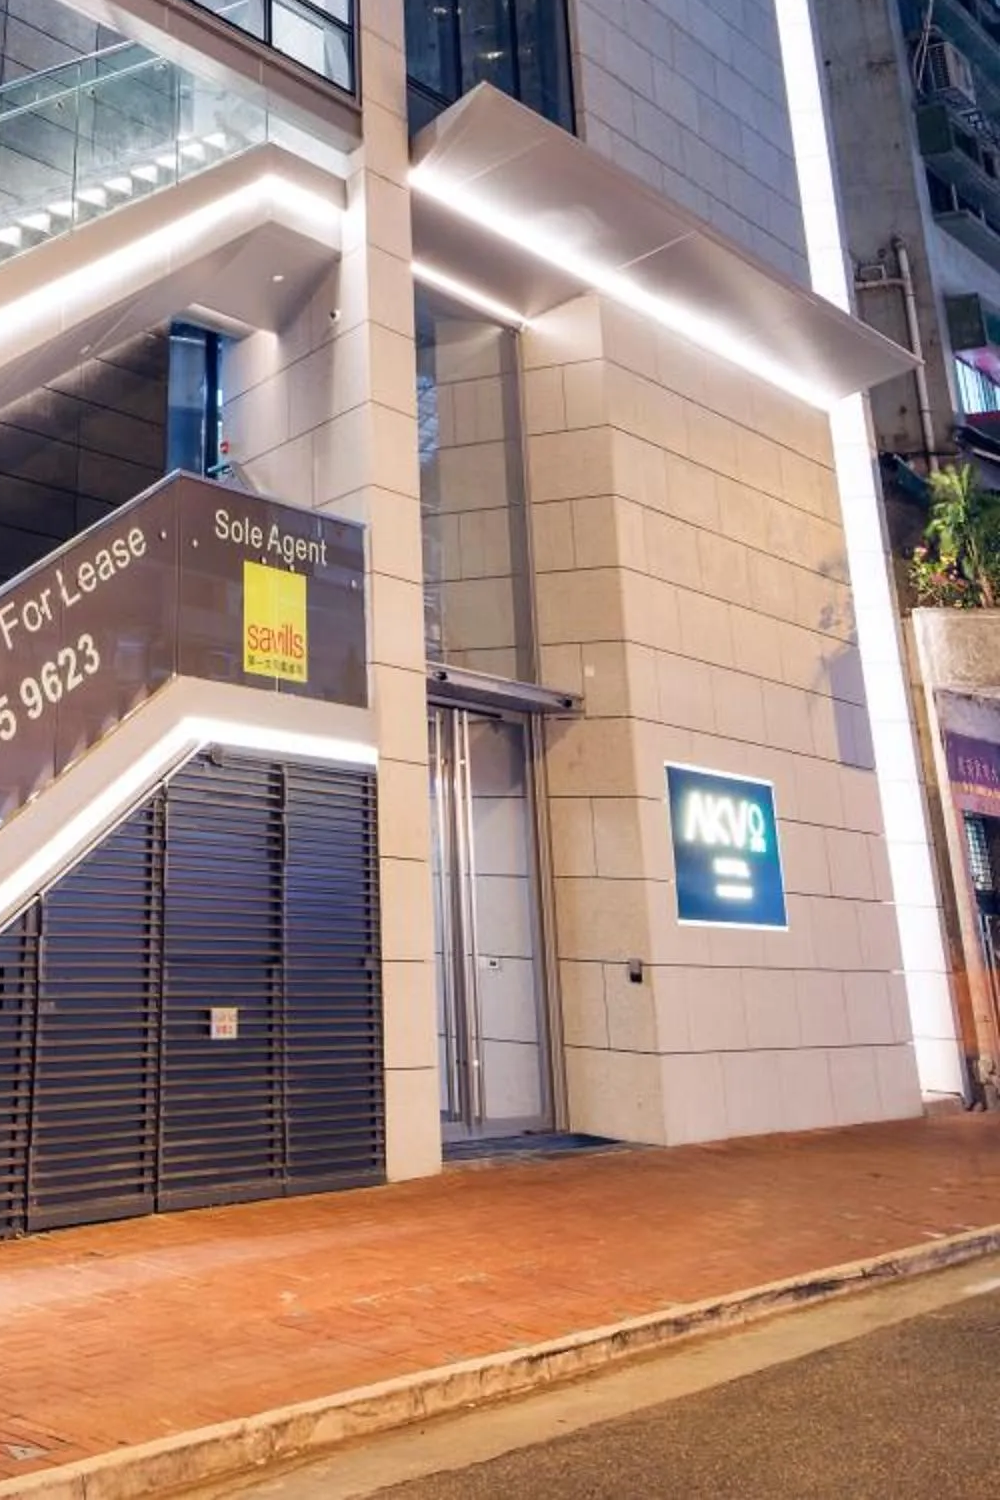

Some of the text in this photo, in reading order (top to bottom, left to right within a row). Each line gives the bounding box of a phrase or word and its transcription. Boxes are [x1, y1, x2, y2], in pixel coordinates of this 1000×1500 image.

[55, 527, 147, 608] Lease
[215, 509, 328, 567] Sole Agent
[247, 622, 304, 660] savills
[18, 633, 101, 721] 9623
